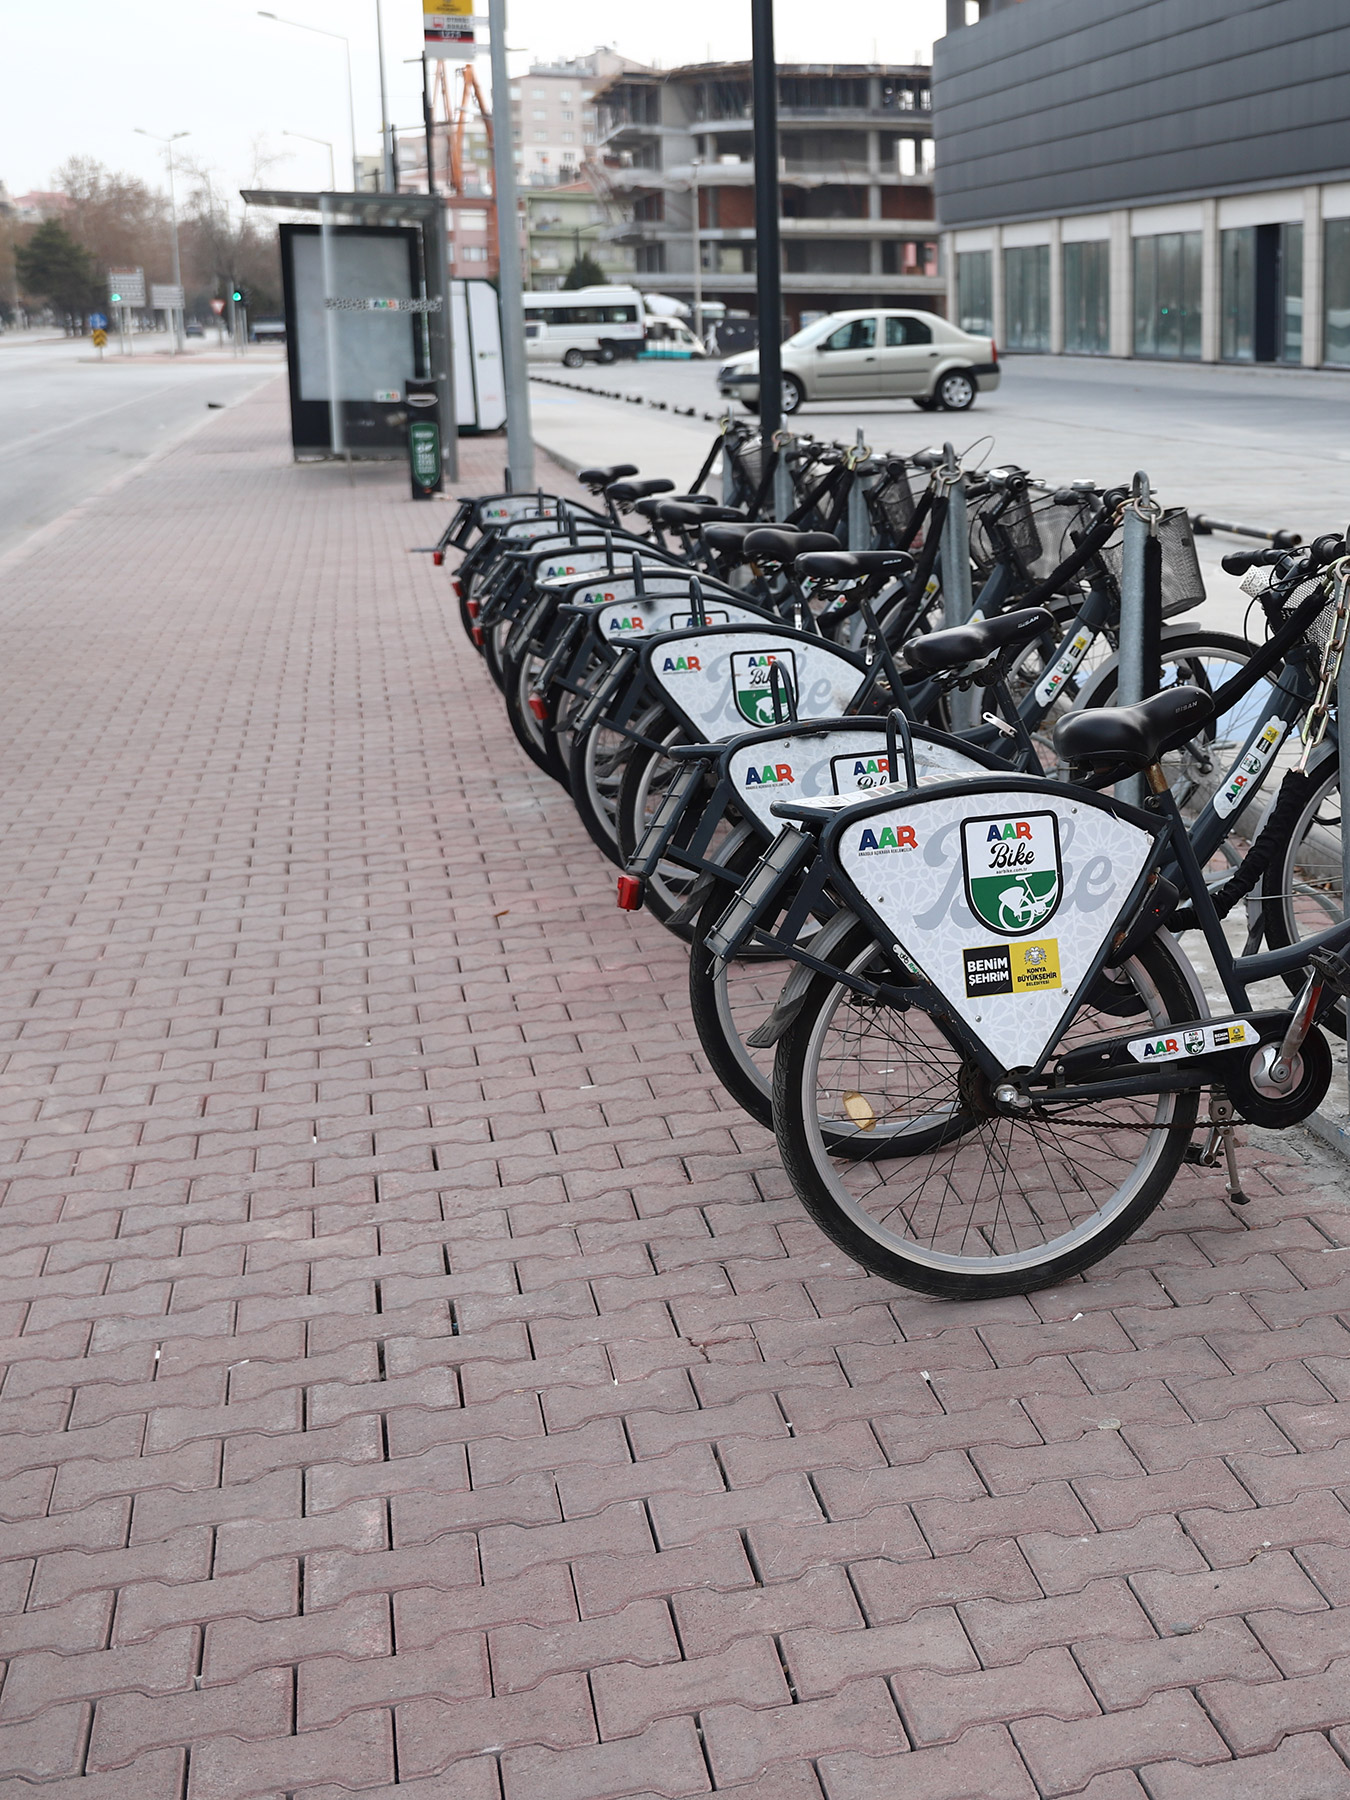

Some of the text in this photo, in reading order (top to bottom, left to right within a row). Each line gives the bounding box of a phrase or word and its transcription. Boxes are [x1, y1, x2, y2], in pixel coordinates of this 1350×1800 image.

[610, 617, 645, 631] AAR
[663, 655, 701, 672] AAR
[1044, 675, 1063, 697] AAR
[745, 764, 795, 785] AAR
[1225, 775, 1248, 804] AAR
[859, 822, 1033, 851] AAR AAR
[988, 842, 1035, 869] Bike
[1144, 1038, 1179, 1057] AAR
